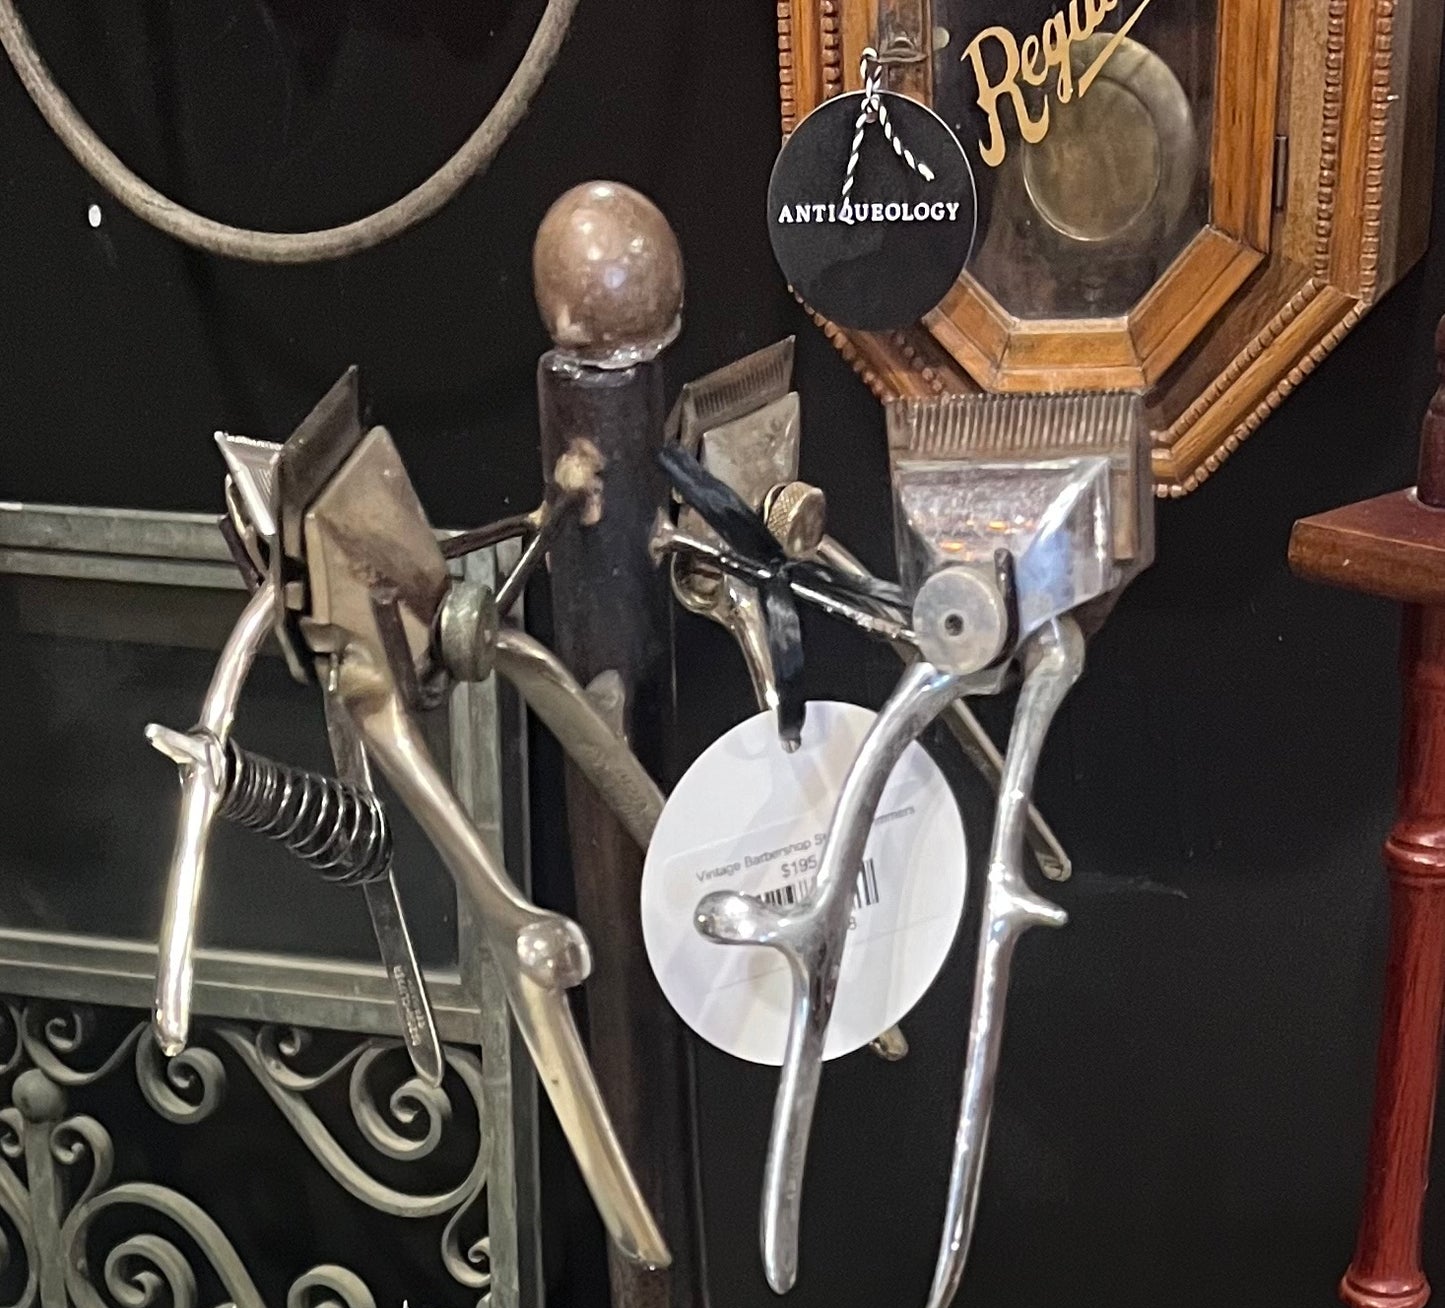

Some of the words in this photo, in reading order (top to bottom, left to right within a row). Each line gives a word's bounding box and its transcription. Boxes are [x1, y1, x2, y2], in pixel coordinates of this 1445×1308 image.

[778, 201, 960, 226] ANTIQUEOLOGY
[696, 861, 742, 882] Vintage
[744, 838, 812, 867] Barbershop
